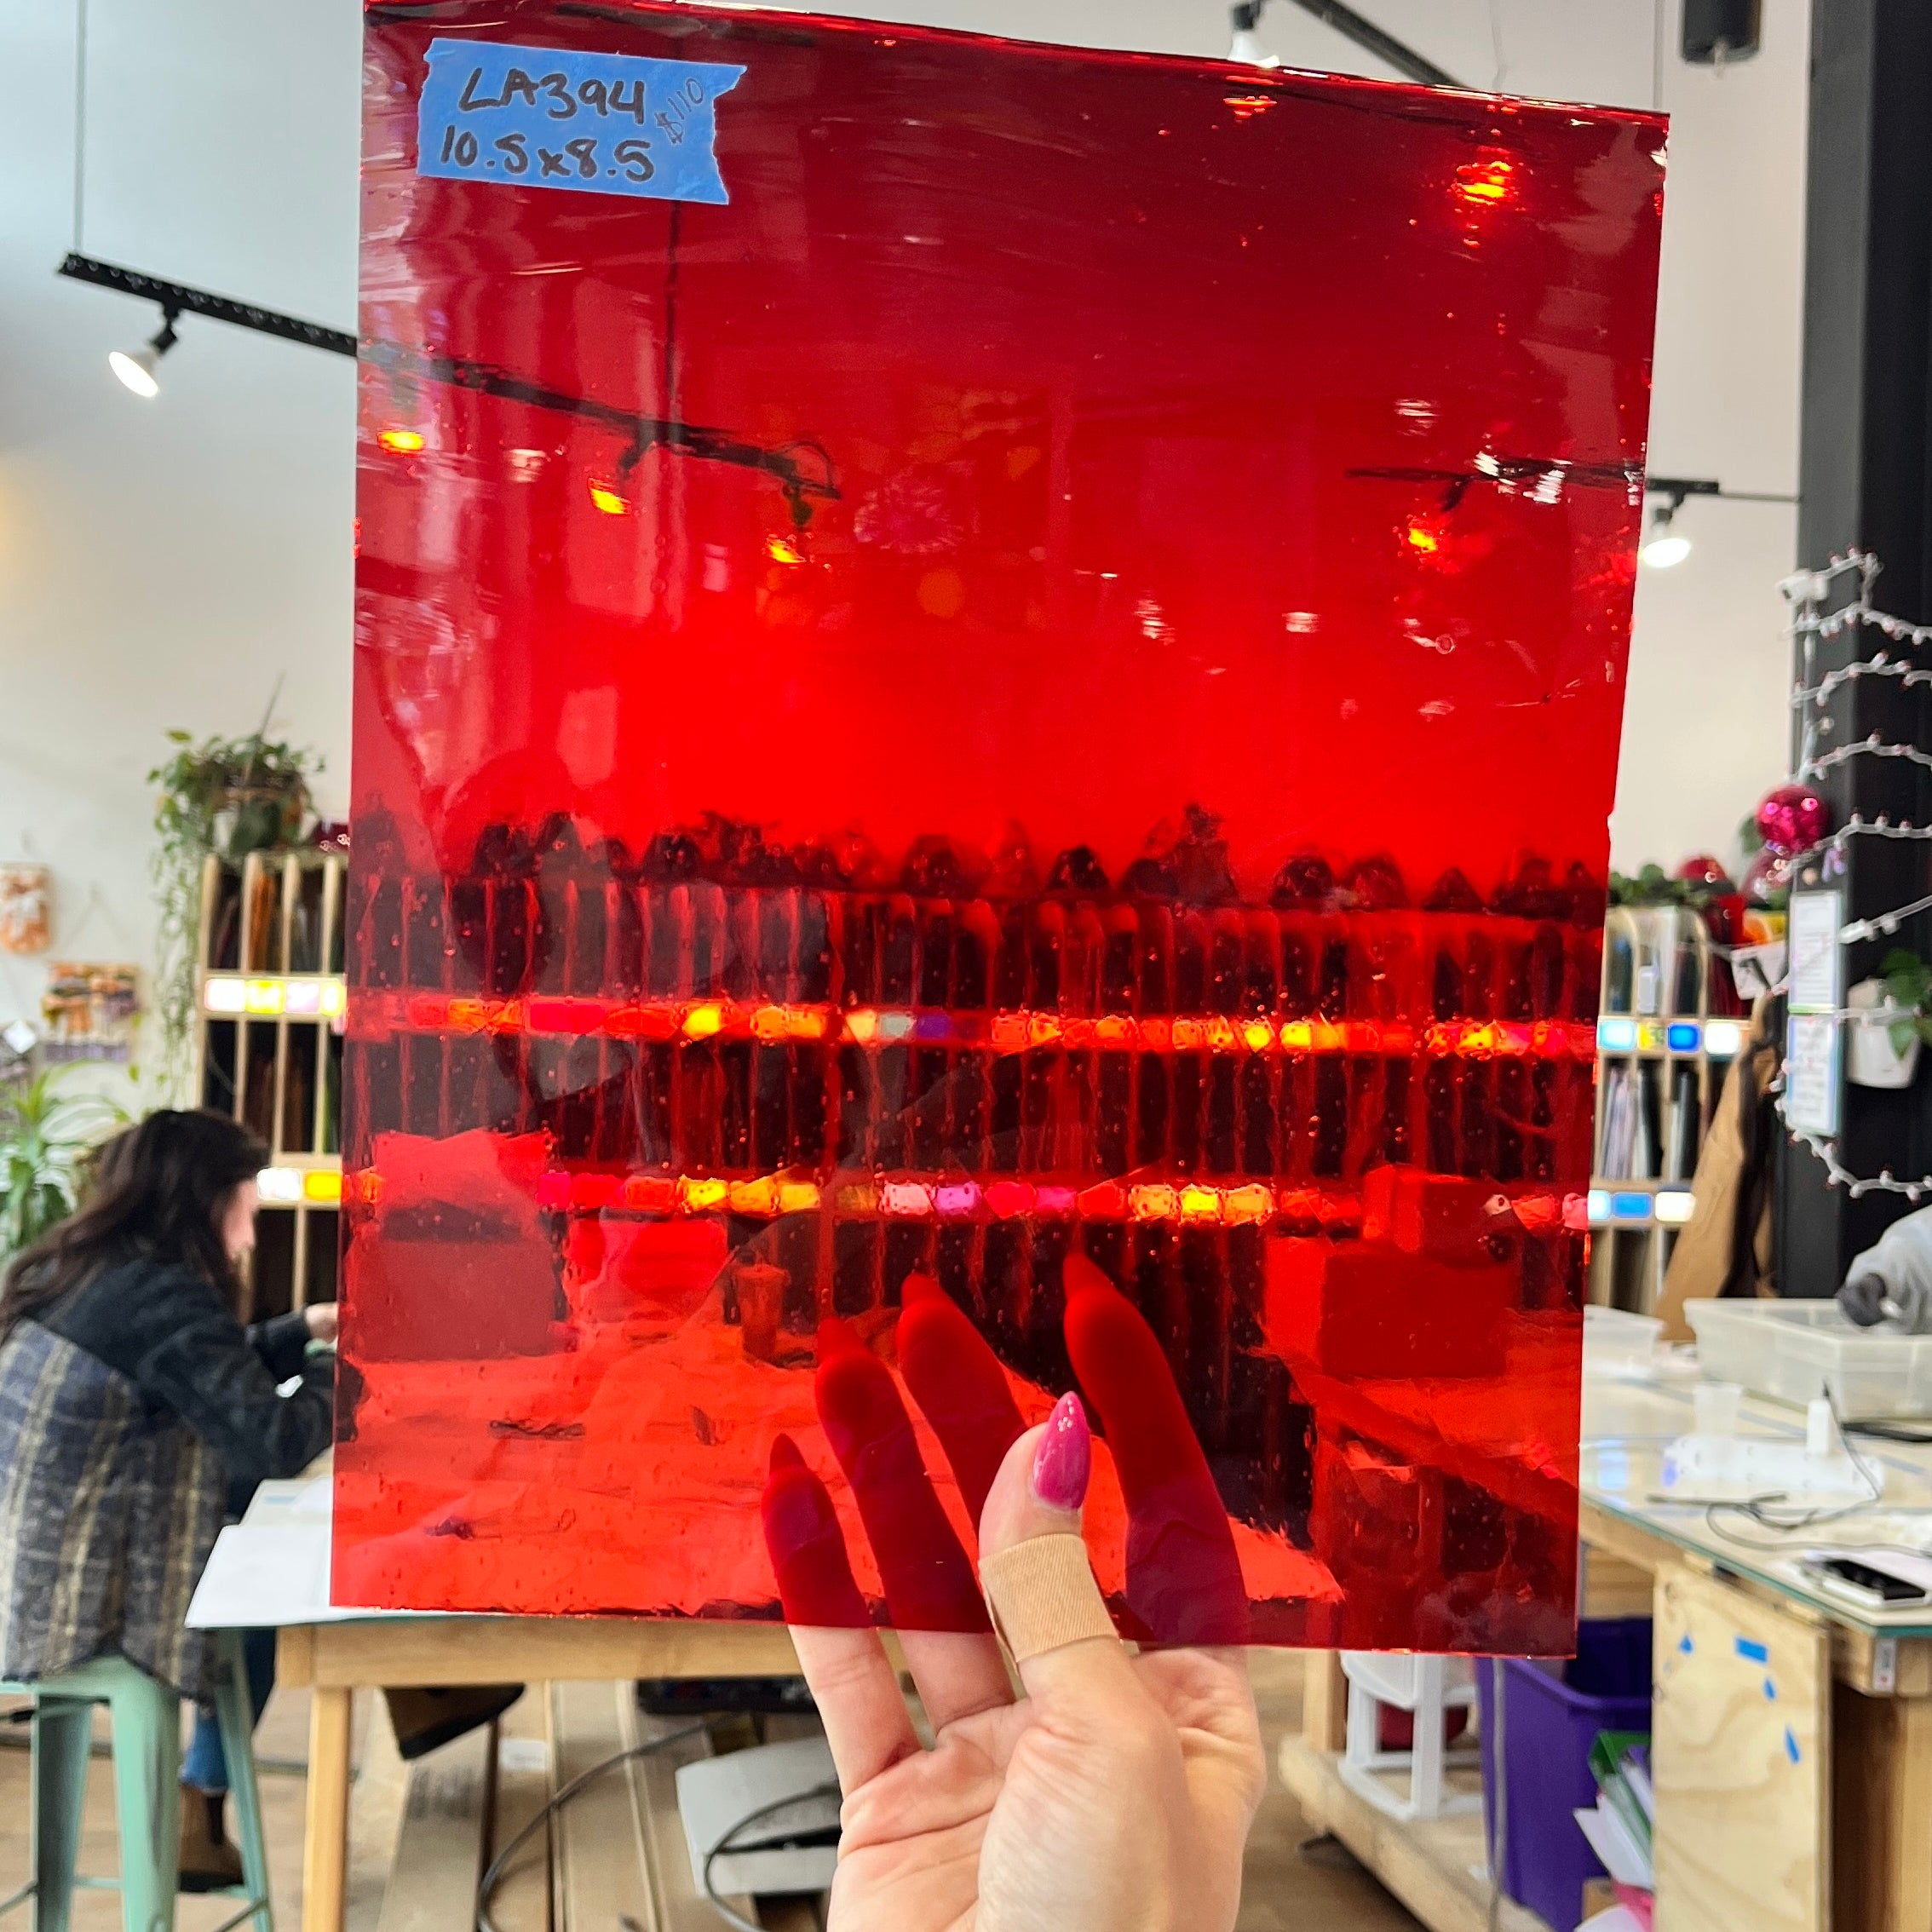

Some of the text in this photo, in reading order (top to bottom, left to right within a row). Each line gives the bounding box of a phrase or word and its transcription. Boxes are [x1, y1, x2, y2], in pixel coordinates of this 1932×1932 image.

[458, 67, 645, 125] LA394
[654, 78, 704, 144] $110
[440, 124, 655, 182] 10.5x8.5
